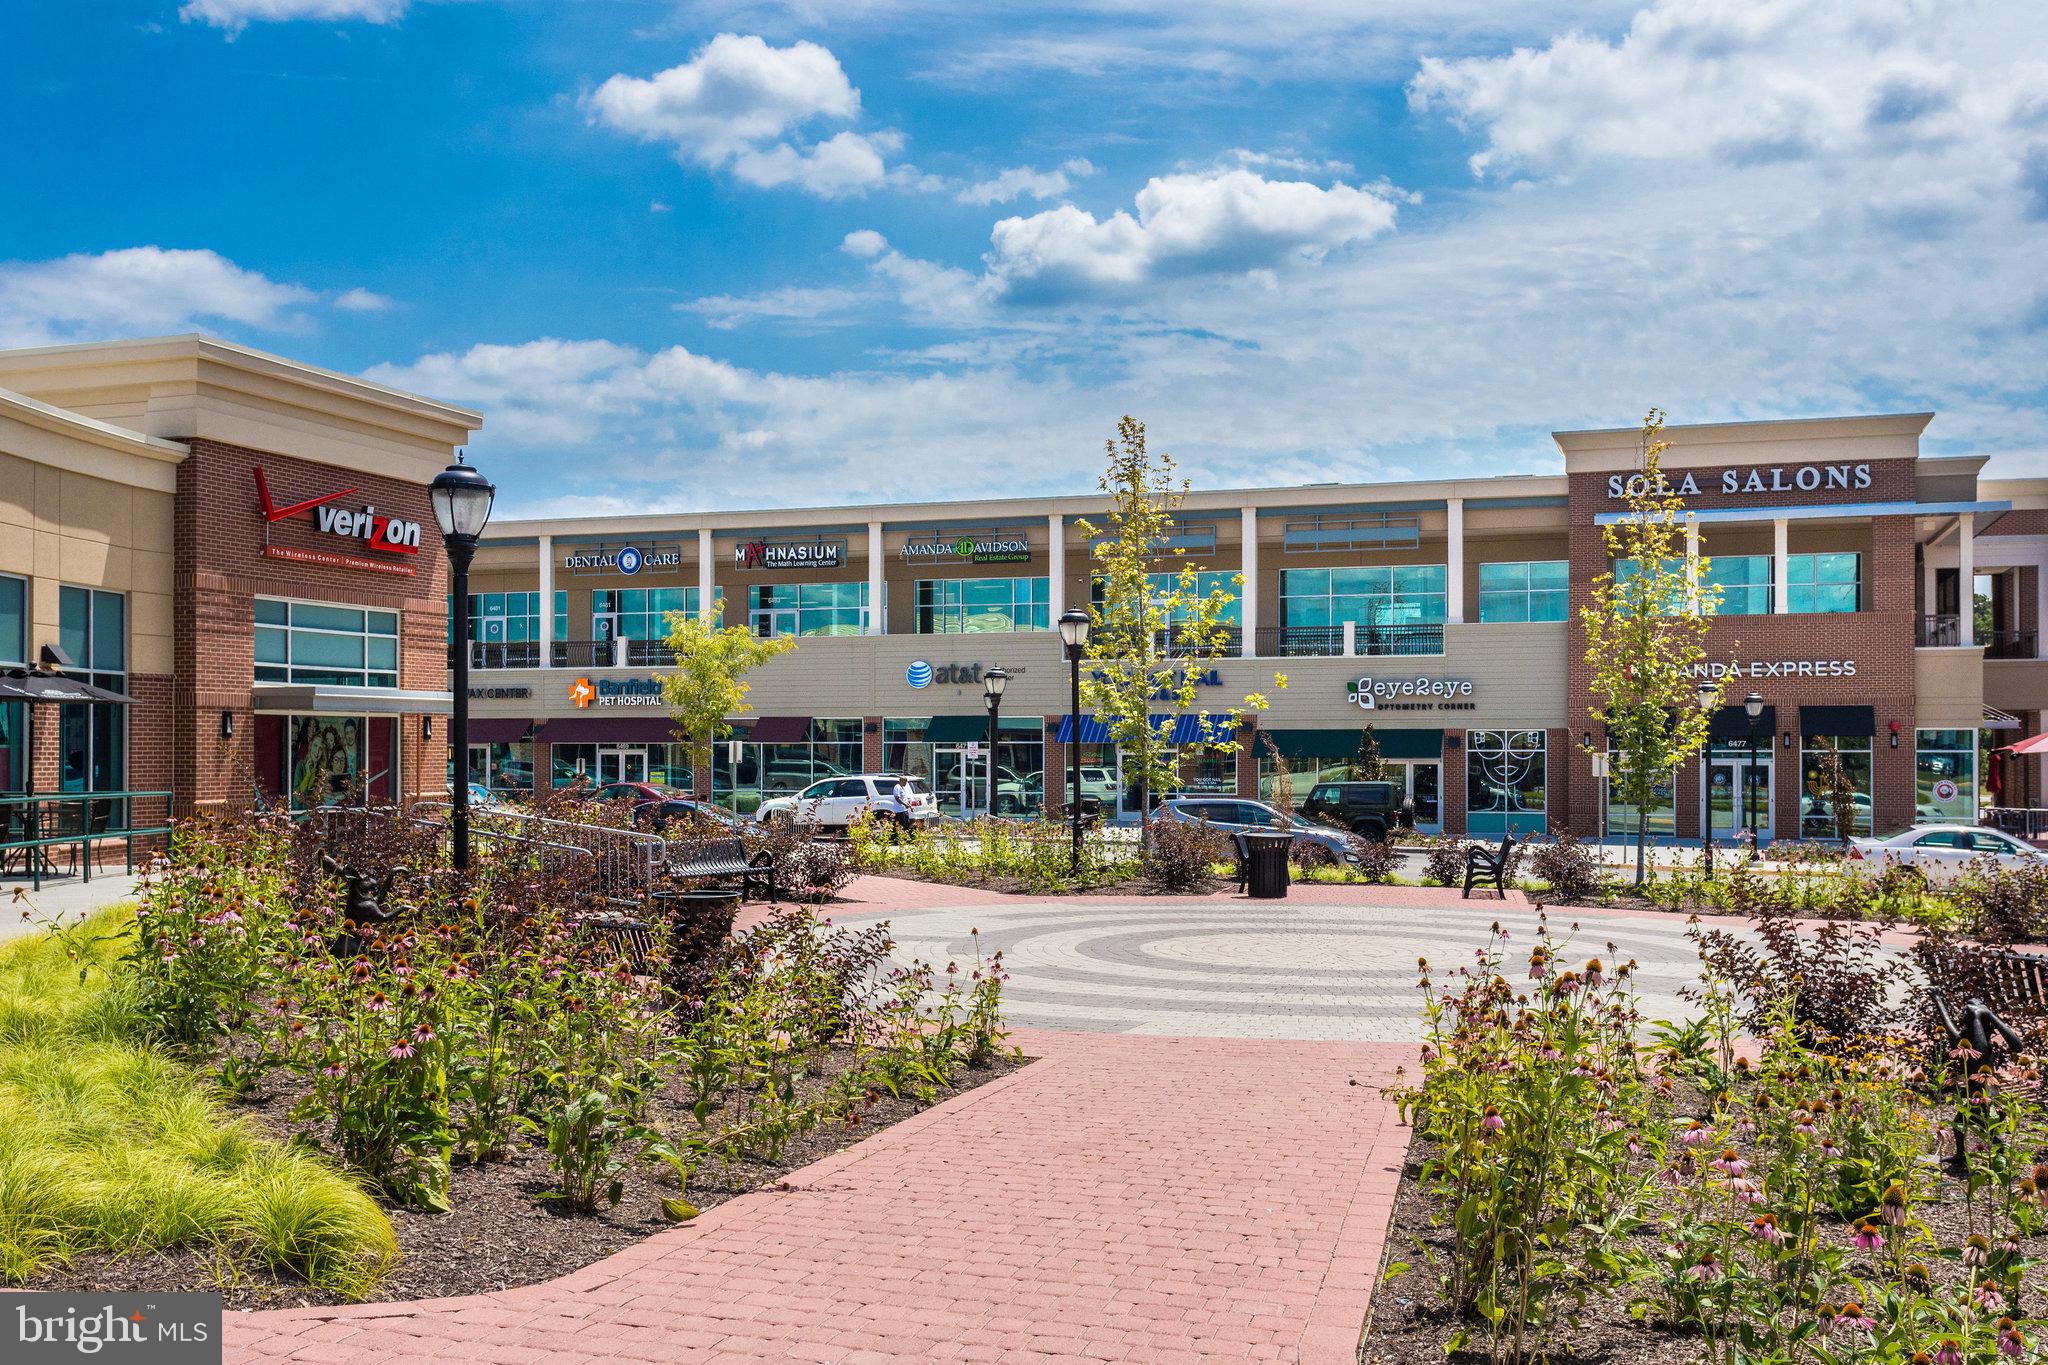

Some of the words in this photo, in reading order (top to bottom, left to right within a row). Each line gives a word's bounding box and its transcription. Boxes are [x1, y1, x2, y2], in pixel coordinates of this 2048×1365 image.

[1608, 472, 1701, 498] SOLA
[1722, 464, 1872, 494] SALONS
[317, 505, 421, 555] verizon
[899, 544, 953, 556] AMANDA
[1008, 553, 1028, 561] Group
[286, 551, 316, 560] Wireless
[317, 555, 340, 563] Center
[345, 559, 369, 567] Premium
[369, 562, 392, 571] Wireless
[392, 565, 413, 573] Retailer
[564, 554, 616, 568] DENTAL
[643, 553, 680, 566] CARE
[793, 560, 817, 568] Learning
[936, 662, 983, 684] at&t
[1001, 666, 1026, 674] horized
[1665, 662, 1742, 678] ANDA
[1750, 660, 1857, 678] EXPRESS
[468, 688, 484, 699] AX
[486, 688, 529, 699] CENTER
[599, 678, 662, 695] Banfield
[1374, 677, 1473, 699] eye2eye
[599, 696, 616, 706] PET
[617, 696, 662, 706] HOSPITAL
[1377, 703, 1434, 711] OPTOMETRY
